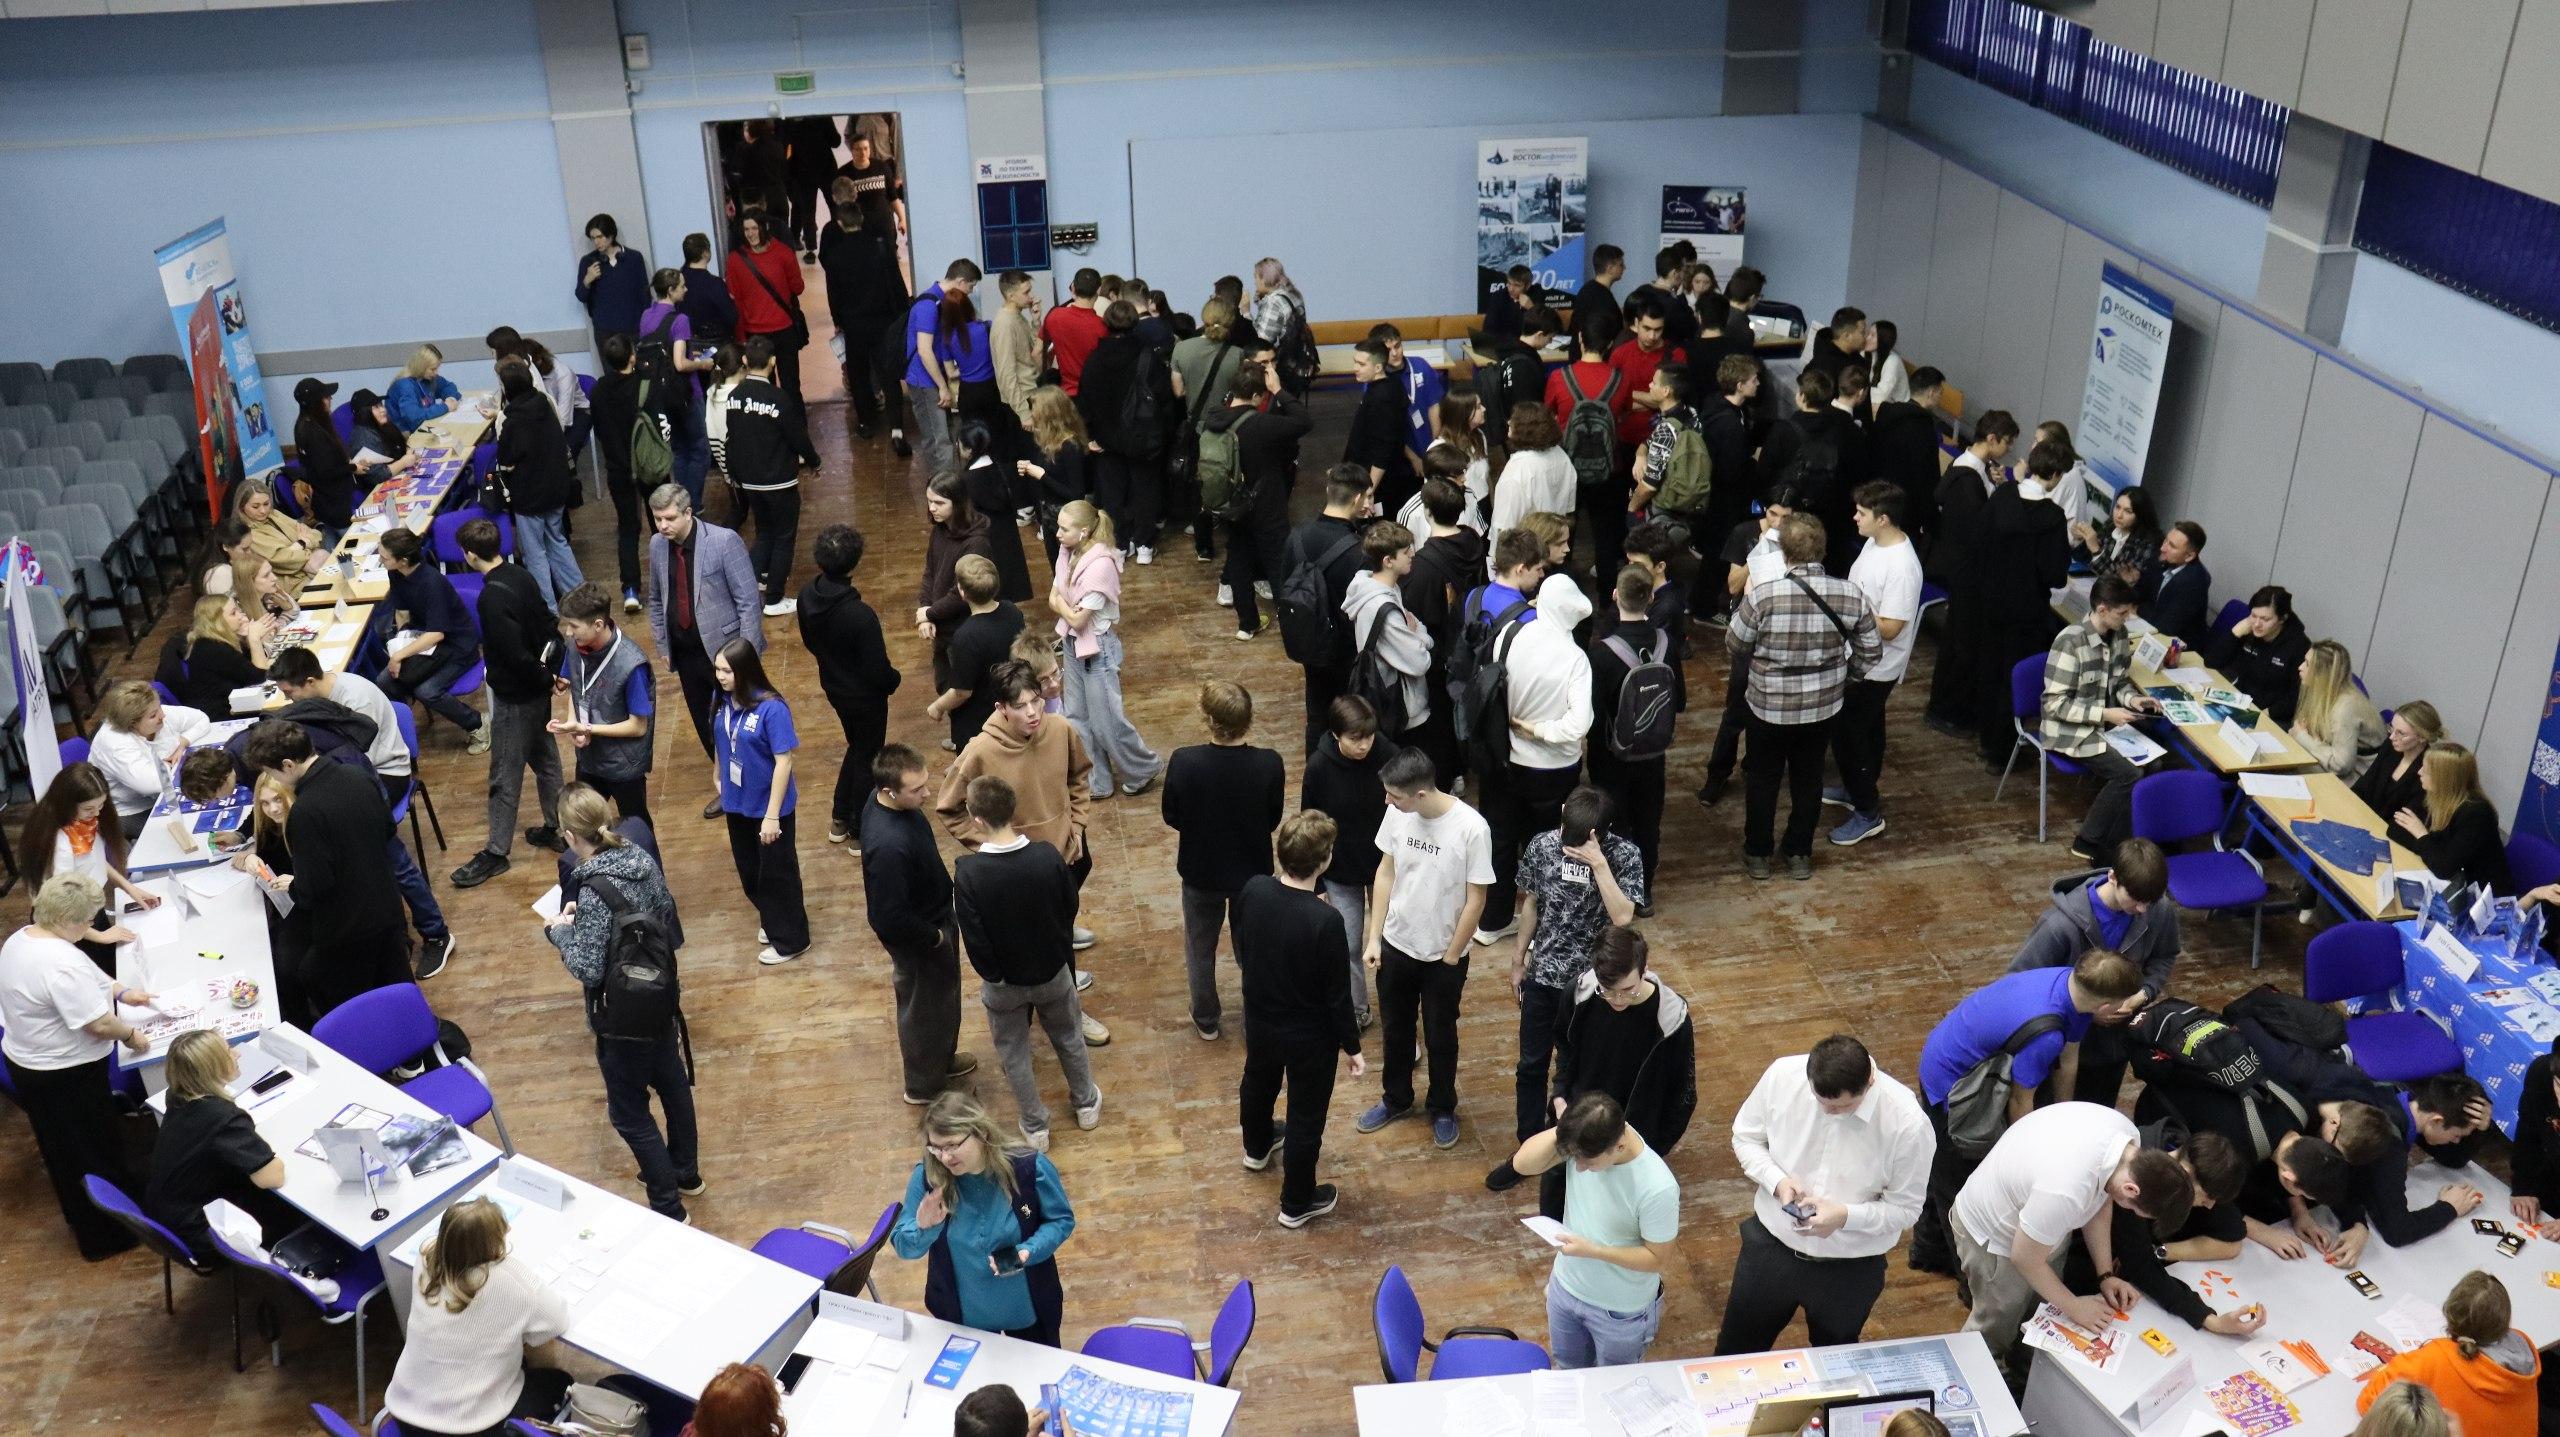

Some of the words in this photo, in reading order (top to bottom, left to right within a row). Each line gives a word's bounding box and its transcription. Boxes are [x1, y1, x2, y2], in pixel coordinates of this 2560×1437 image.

[2114, 302, 2164, 339] РОСКОМТЕХ
[744, 397, 780, 418] Angels
[1406, 836, 1442, 856] BEAST
[1561, 862, 1591, 878] NEVER
